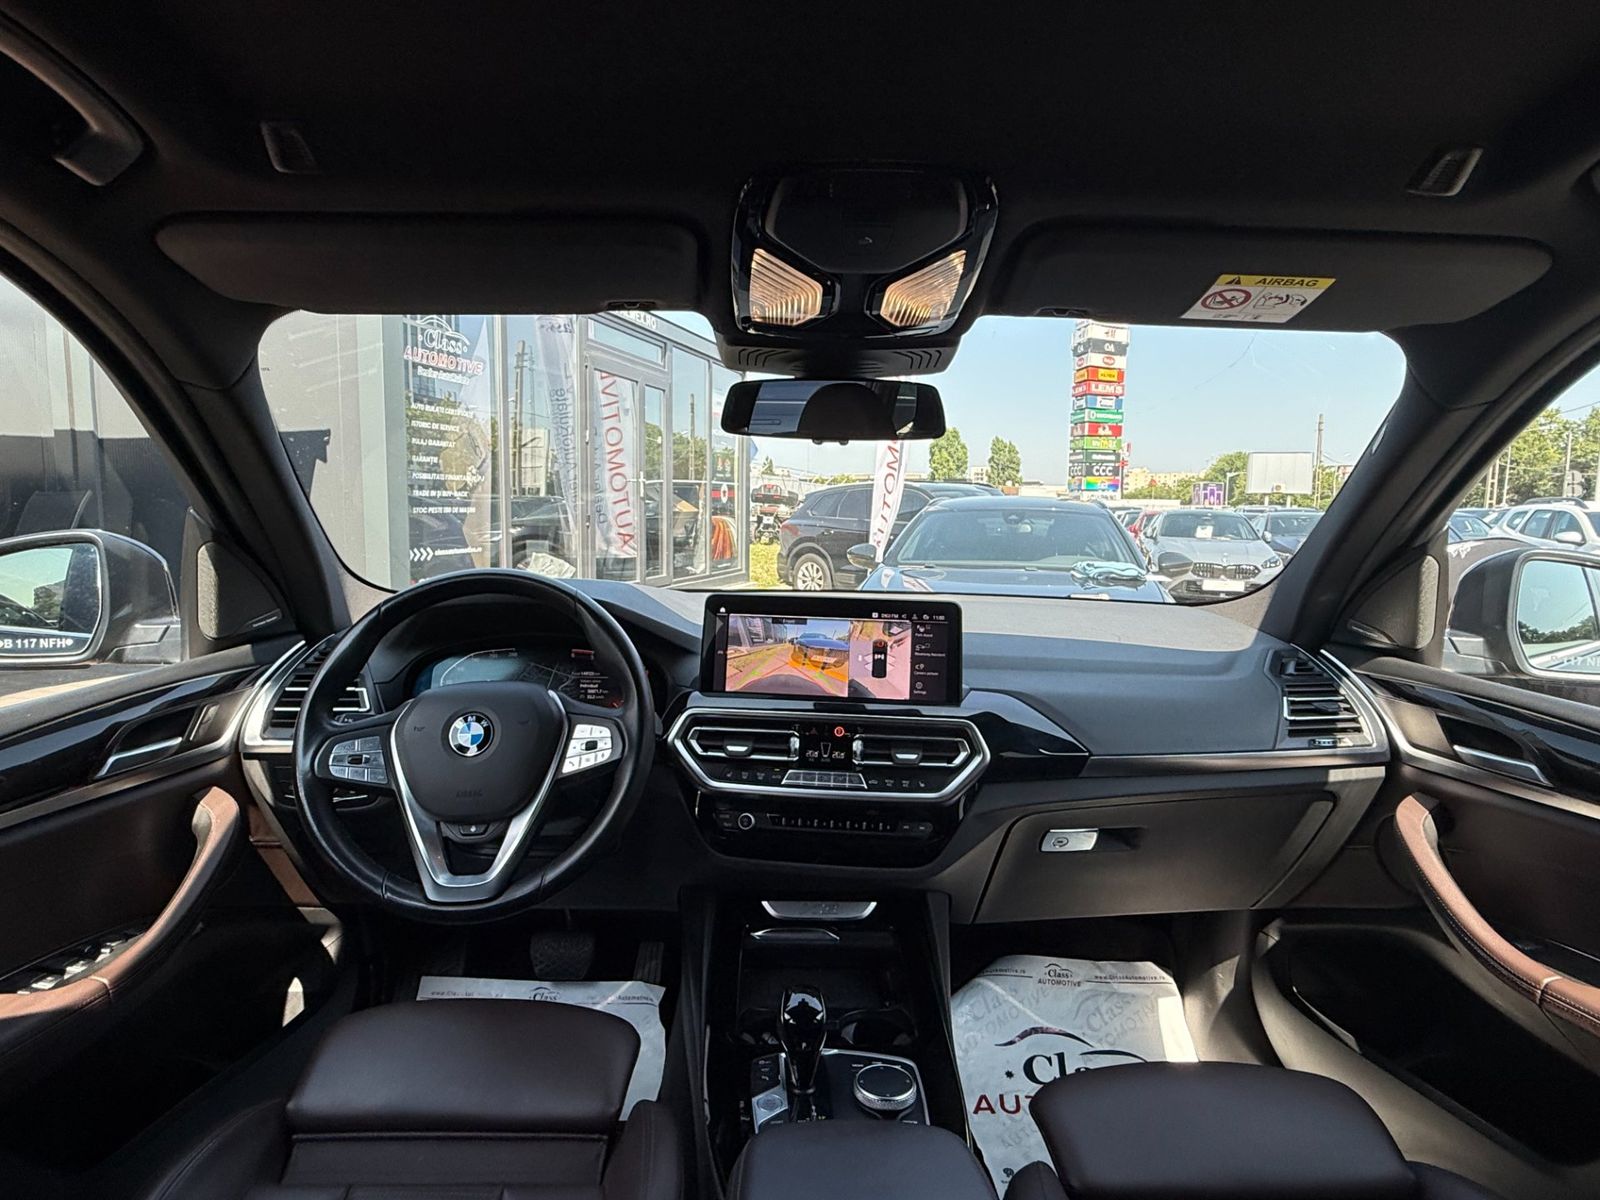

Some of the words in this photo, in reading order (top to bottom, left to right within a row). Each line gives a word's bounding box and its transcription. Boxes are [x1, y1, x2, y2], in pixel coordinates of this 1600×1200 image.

[1255, 277, 1319, 287] AIRBAG
[423, 329, 463, 354] Class
[403, 345, 484, 376] AUTOMOTIVE
[1070, 466, 1082, 476] CCC
[1092, 466, 1113, 476] CCC
[3, 638, 13, 649] B
[16, 638, 37, 649] 117
[40, 638, 67, 649] NFH
[1048, 969, 1069, 979] Class
[1037, 978, 1081, 988] AUTOMOTIVE
